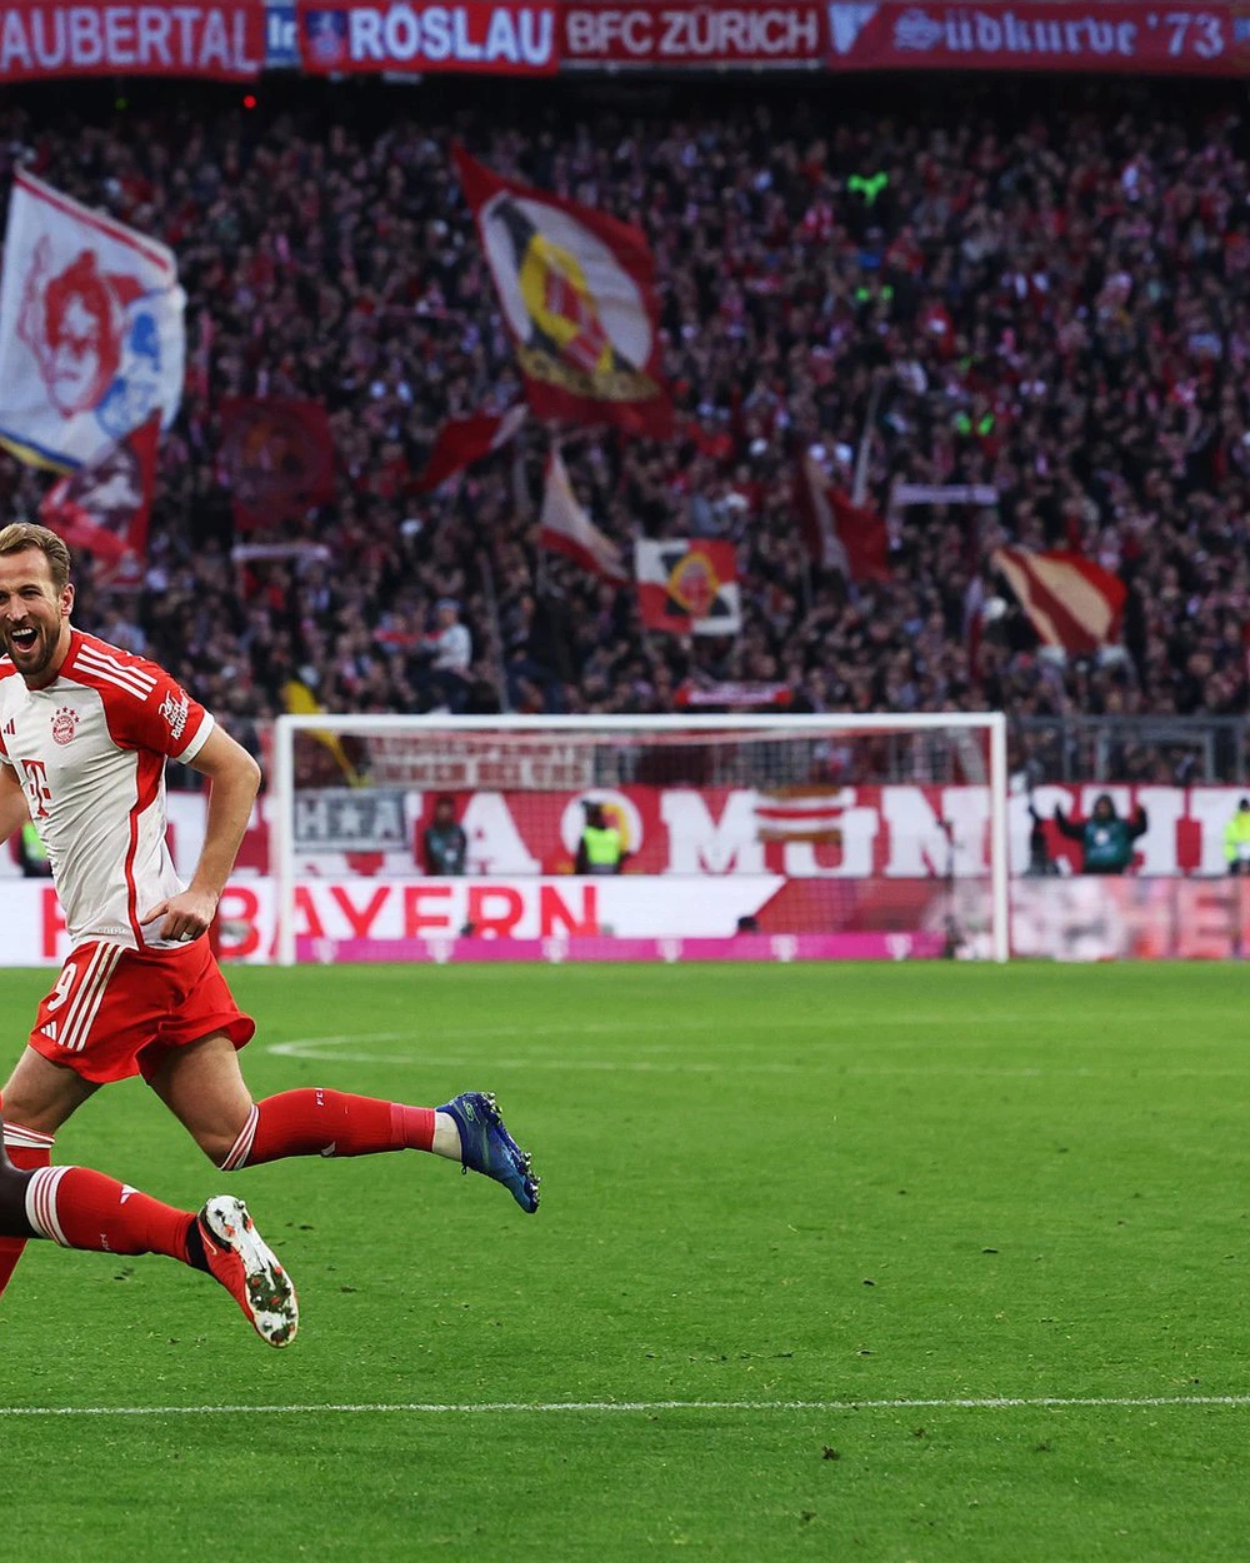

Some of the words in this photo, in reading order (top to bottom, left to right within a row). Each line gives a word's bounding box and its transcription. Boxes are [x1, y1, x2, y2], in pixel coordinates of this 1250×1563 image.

[350, 0, 550, 65] RÖSLAU
[566, 13, 654, 54] BFC
[659, 6, 818, 54] ZÜRICH
[47, 962, 78, 1012] 9
